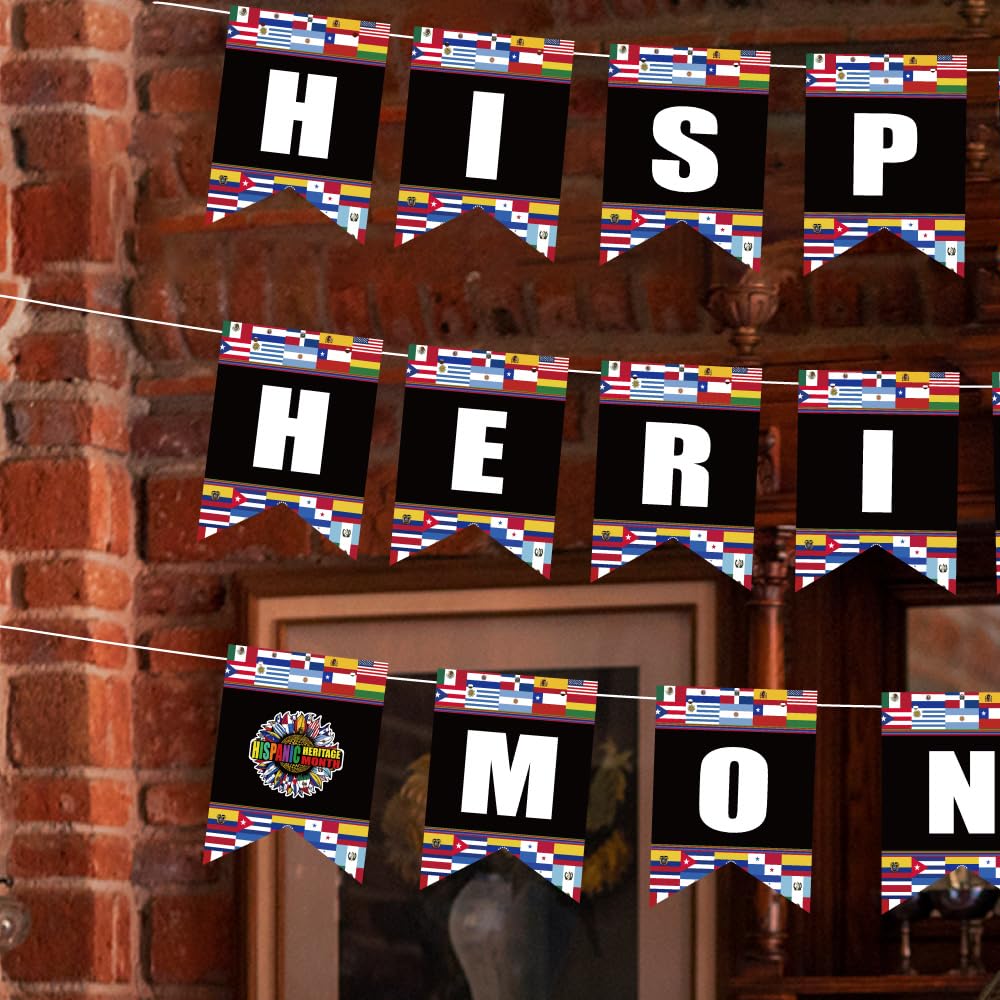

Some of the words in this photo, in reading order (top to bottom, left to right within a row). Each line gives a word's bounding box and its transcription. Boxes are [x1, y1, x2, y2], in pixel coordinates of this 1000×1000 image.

[252, 740, 301, 764] HISPANIC
[302, 747, 341, 759] HERITAGE
[301, 756, 341, 768] MONTH
